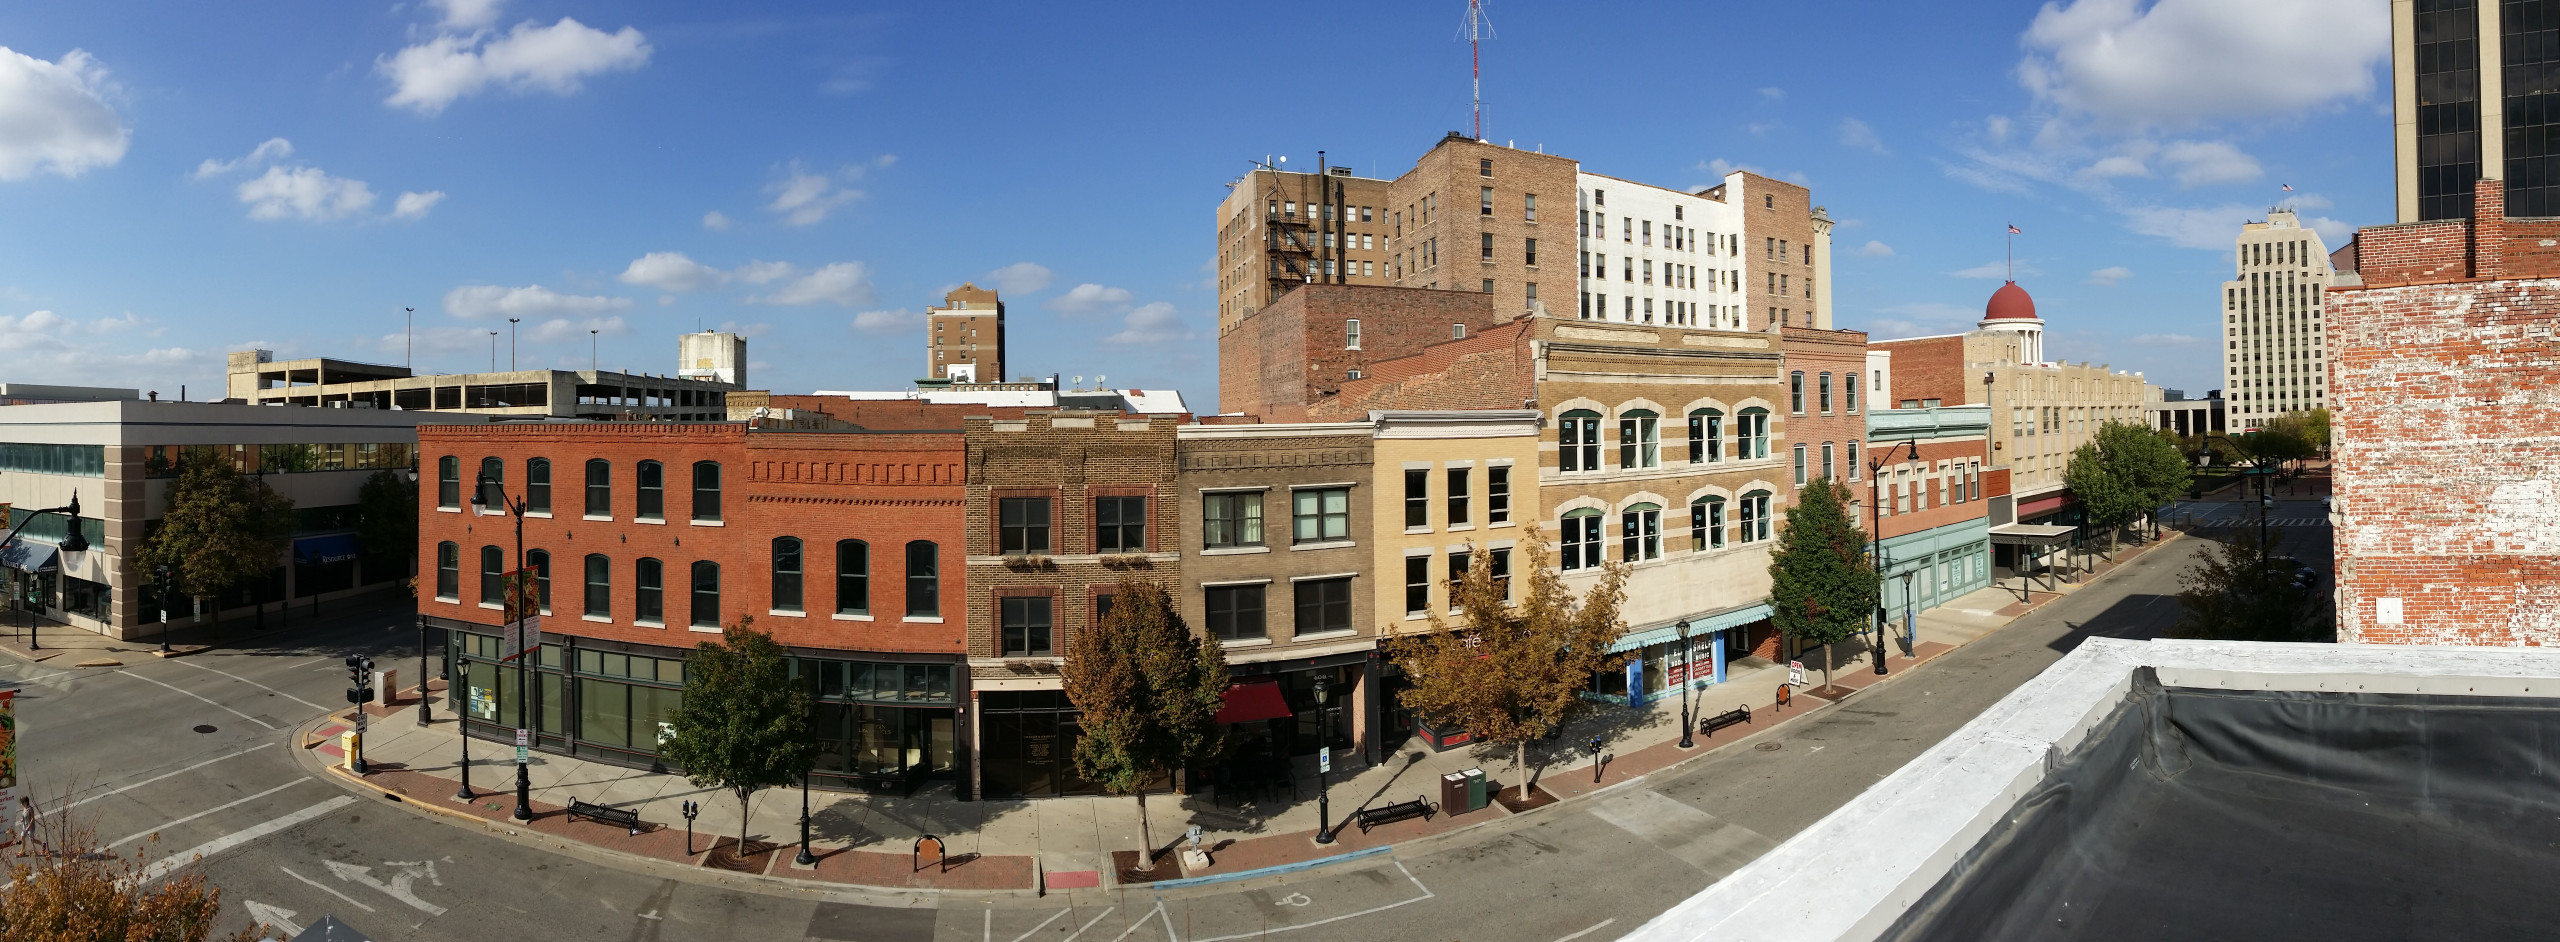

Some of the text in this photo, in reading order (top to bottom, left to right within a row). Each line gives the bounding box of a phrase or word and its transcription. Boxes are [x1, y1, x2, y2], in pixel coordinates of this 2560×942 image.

[1693, 640, 1712, 652] SHELF
[1695, 652, 1710, 661] MUSIC
[1792, 661, 1802, 669] OPEN
